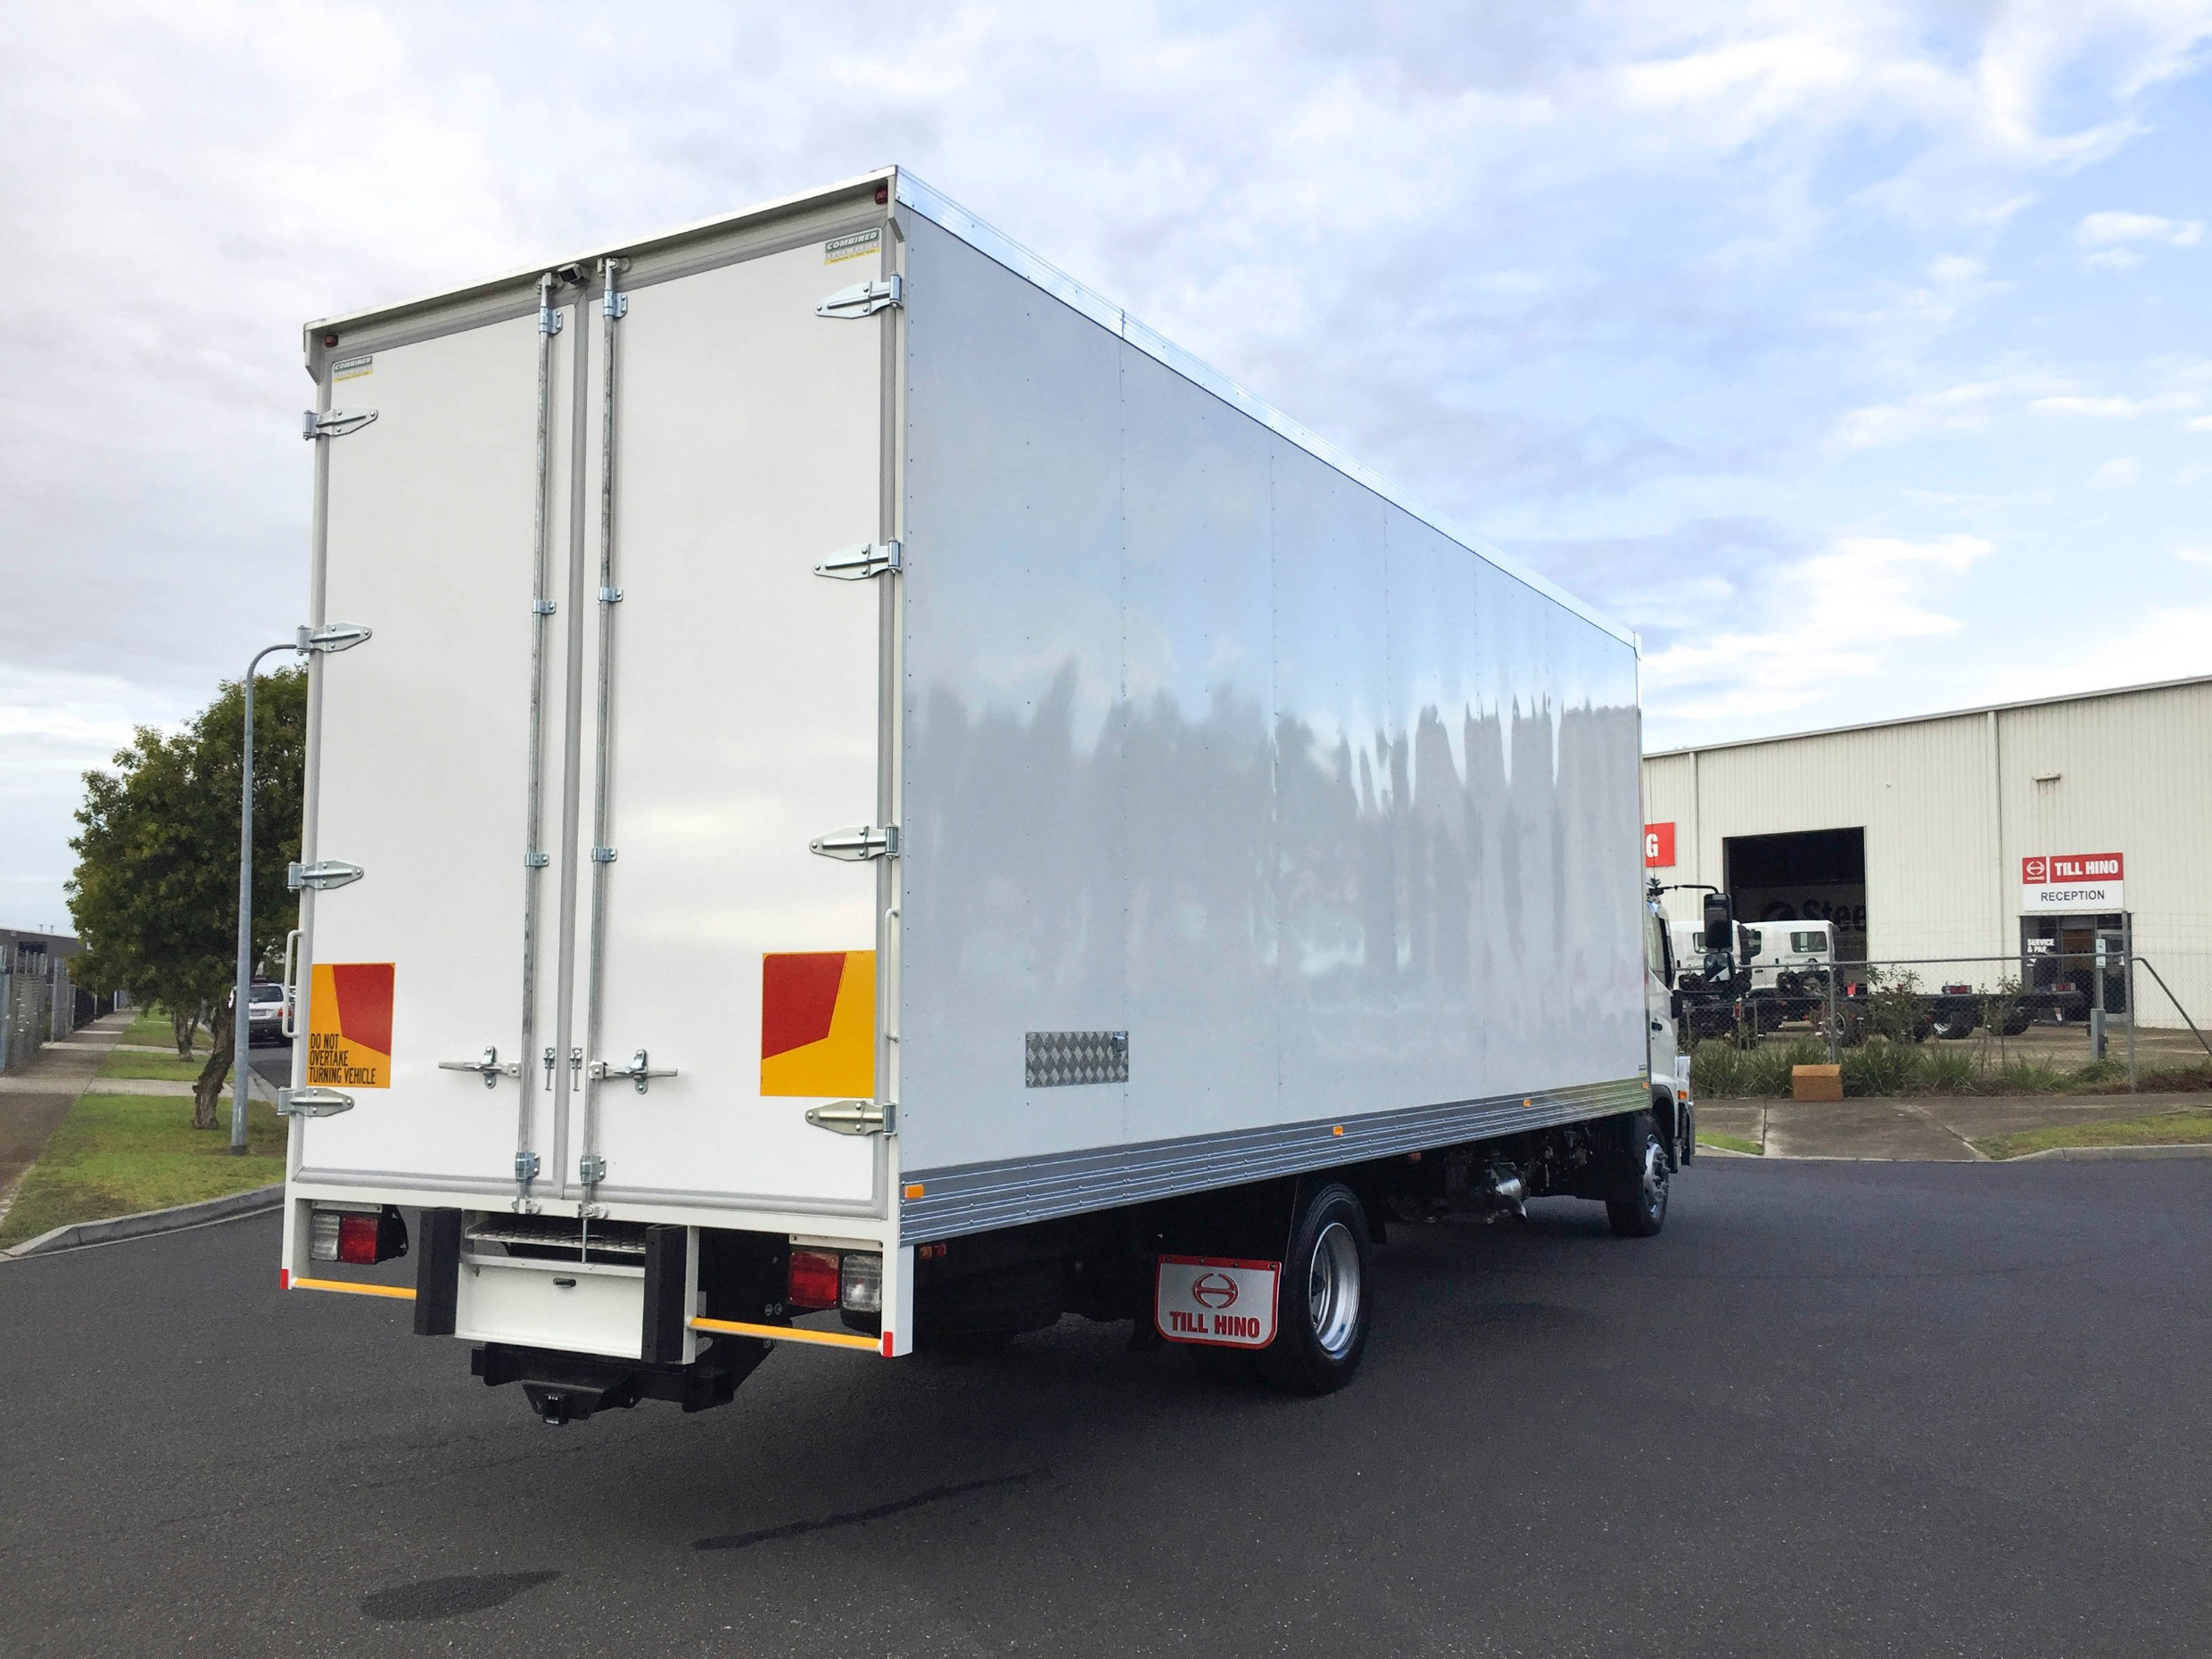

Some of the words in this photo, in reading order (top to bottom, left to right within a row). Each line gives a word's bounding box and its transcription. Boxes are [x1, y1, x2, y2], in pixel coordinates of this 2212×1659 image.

[826, 232, 878, 251] COMBINED
[2054, 862, 2083, 876] TILL
[2085, 859, 2118, 875] HINO
[2041, 889, 2105, 902] RECEPTION
[2026, 938, 2055, 946] SERVICE
[310, 1033, 321, 1050] DO
[324, 1033, 339, 1050] NOT
[310, 1050, 349, 1067] OVERTAKE
[309, 1067, 342, 1084] TURNING
[344, 1068, 376, 1085] VEHICLE
[1169, 1310, 1209, 1333] TILL
[1215, 1314, 1260, 1339] HINO
